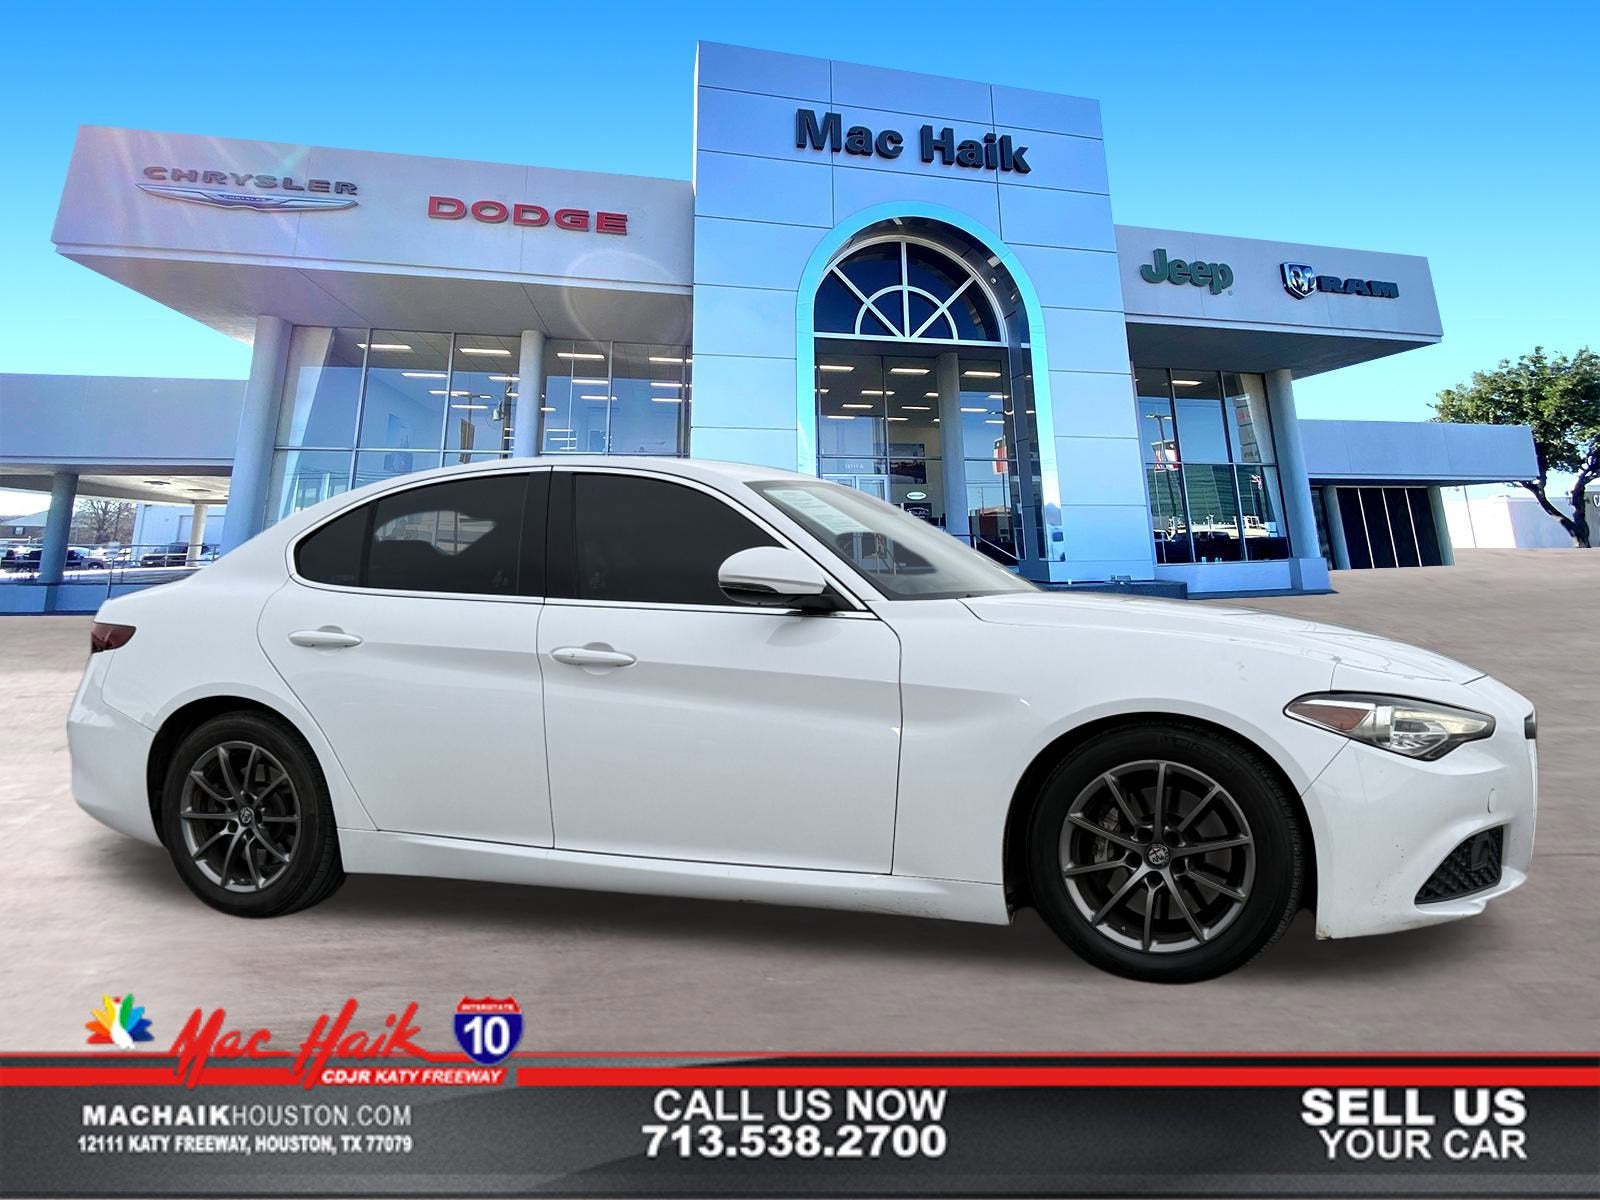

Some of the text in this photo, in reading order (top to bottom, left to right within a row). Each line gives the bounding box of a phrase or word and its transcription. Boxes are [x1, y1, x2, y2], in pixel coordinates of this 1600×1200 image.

[796, 108, 1032, 174] Mac Haik
[143, 166, 358, 196] CHRYSLER
[428, 196, 628, 236] DODGE
[1140, 248, 1234, 295] Jeep
[1316, 275, 1399, 298] RAM
